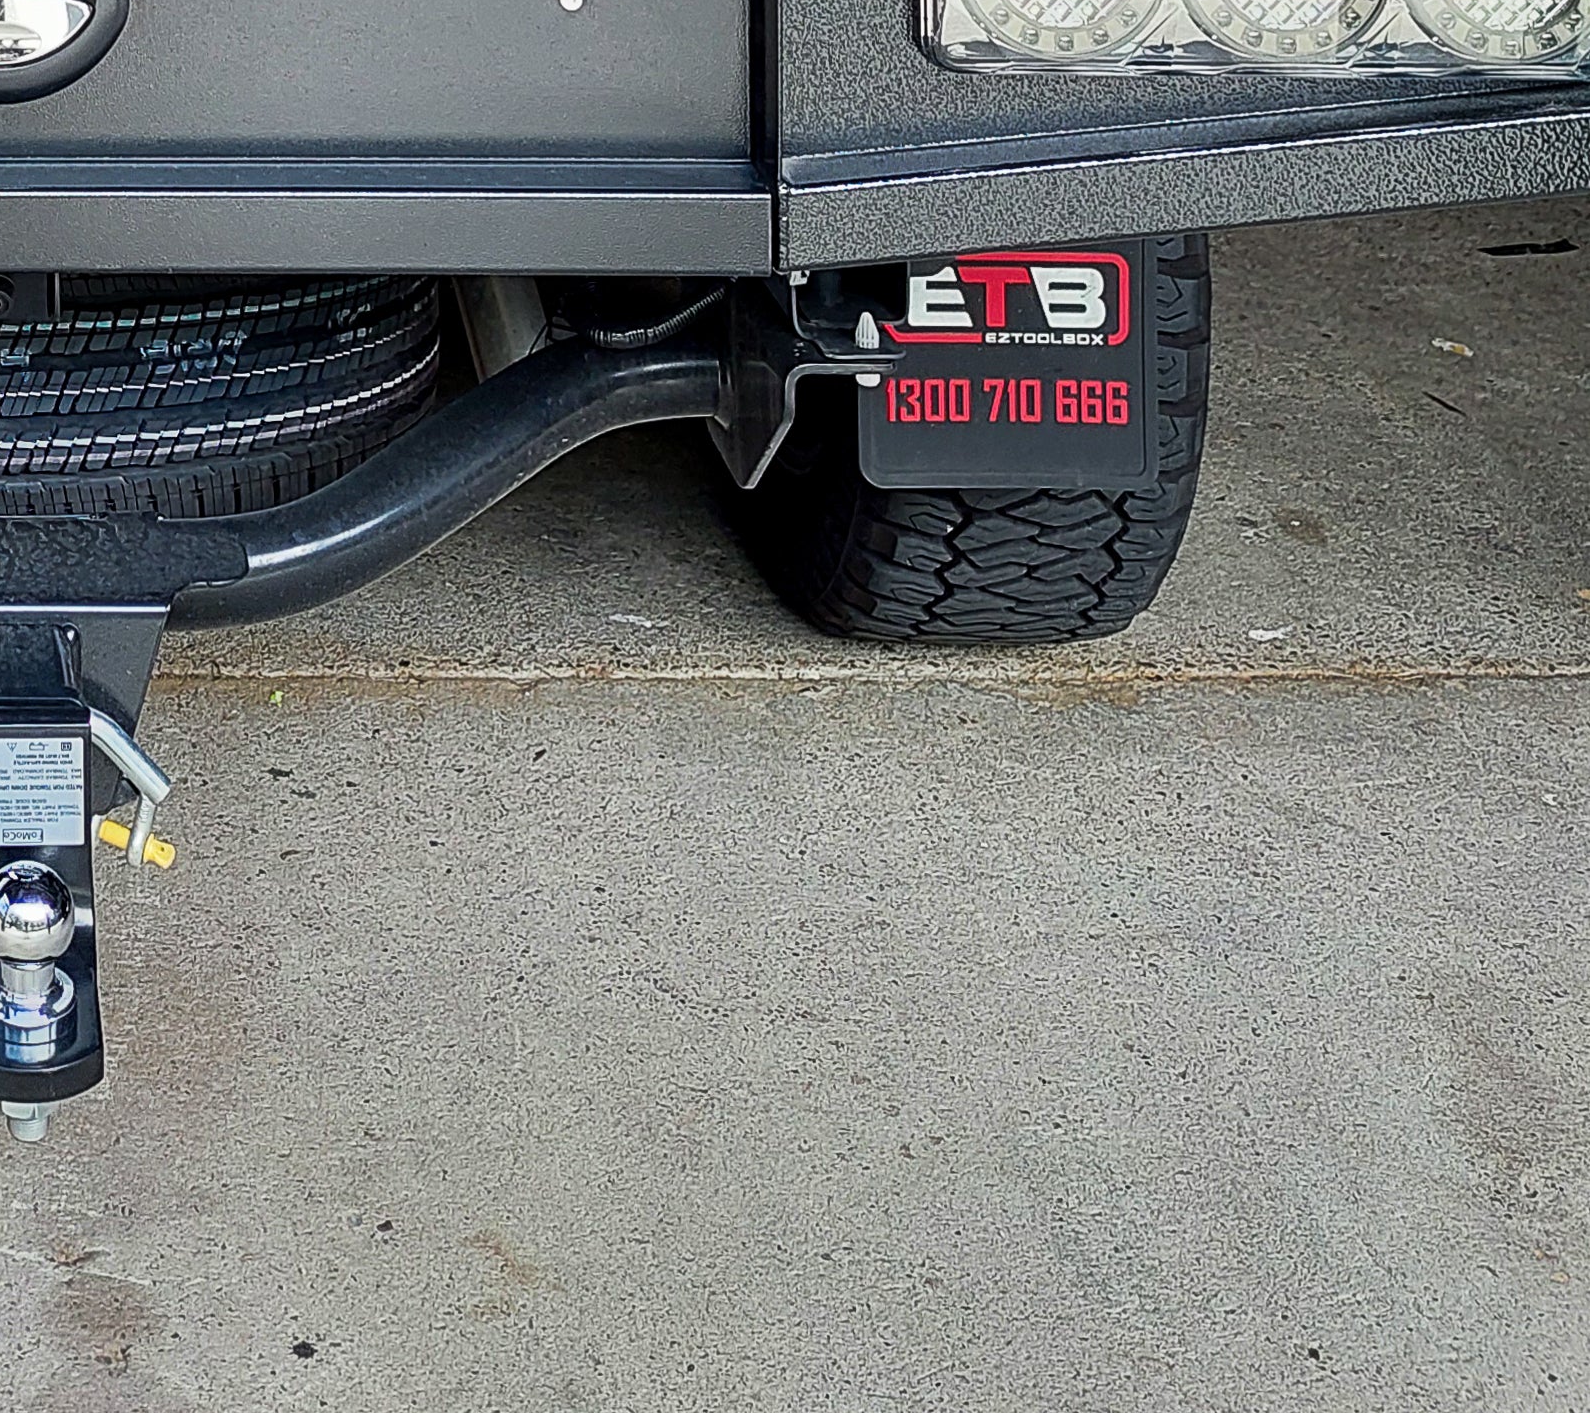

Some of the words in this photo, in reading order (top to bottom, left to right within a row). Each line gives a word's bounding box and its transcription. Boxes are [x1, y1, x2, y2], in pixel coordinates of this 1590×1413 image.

[908, 266, 1107, 329] ETB
[985, 332, 1105, 346] EZTOOLBOX
[885, 378, 971, 422] 1300
[983, 378, 1042, 422] 710
[1056, 379, 1129, 424] 666
